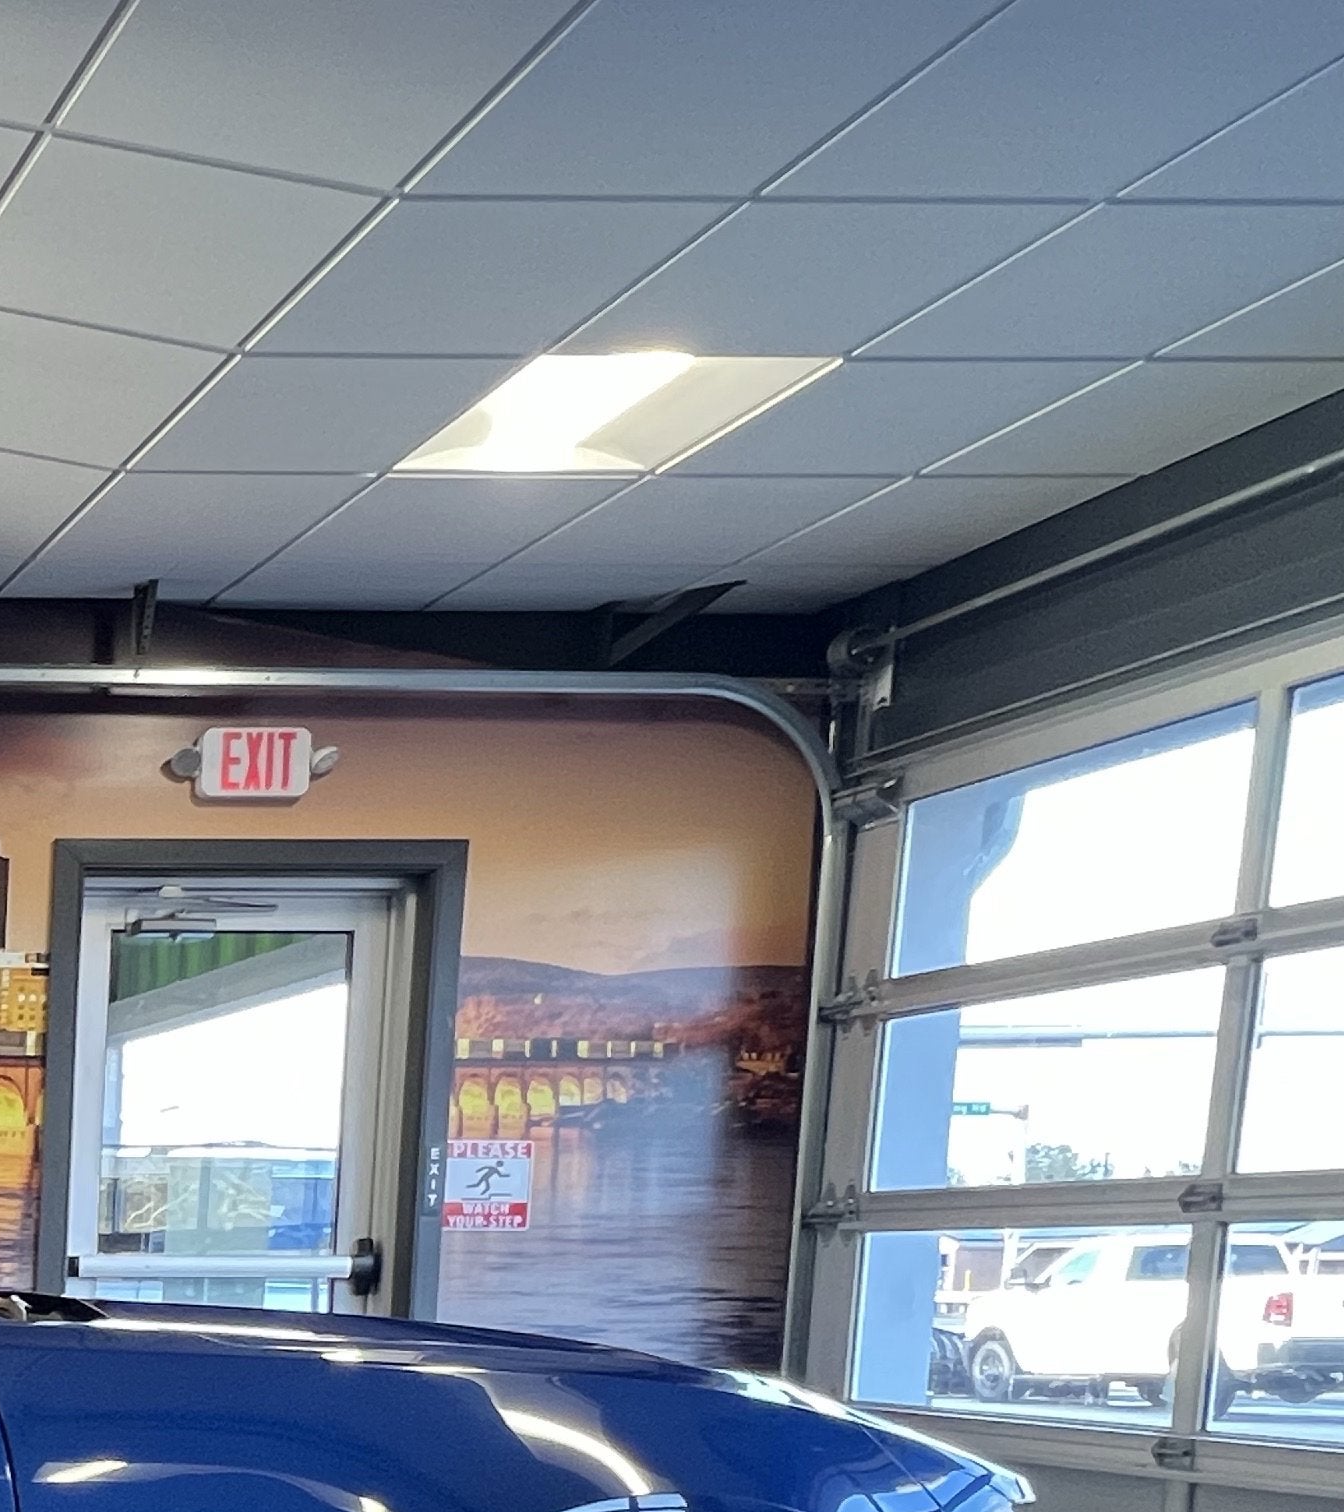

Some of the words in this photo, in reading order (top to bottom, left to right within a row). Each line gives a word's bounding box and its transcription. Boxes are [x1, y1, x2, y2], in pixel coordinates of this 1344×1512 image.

[220, 731, 297, 790] EXIT
[453, 1142, 529, 1158] PLEASE
[427, 1147, 440, 1207] EXIT
[463, 1202, 510, 1215] WATCH
[489, 1215, 524, 1228] STEP
